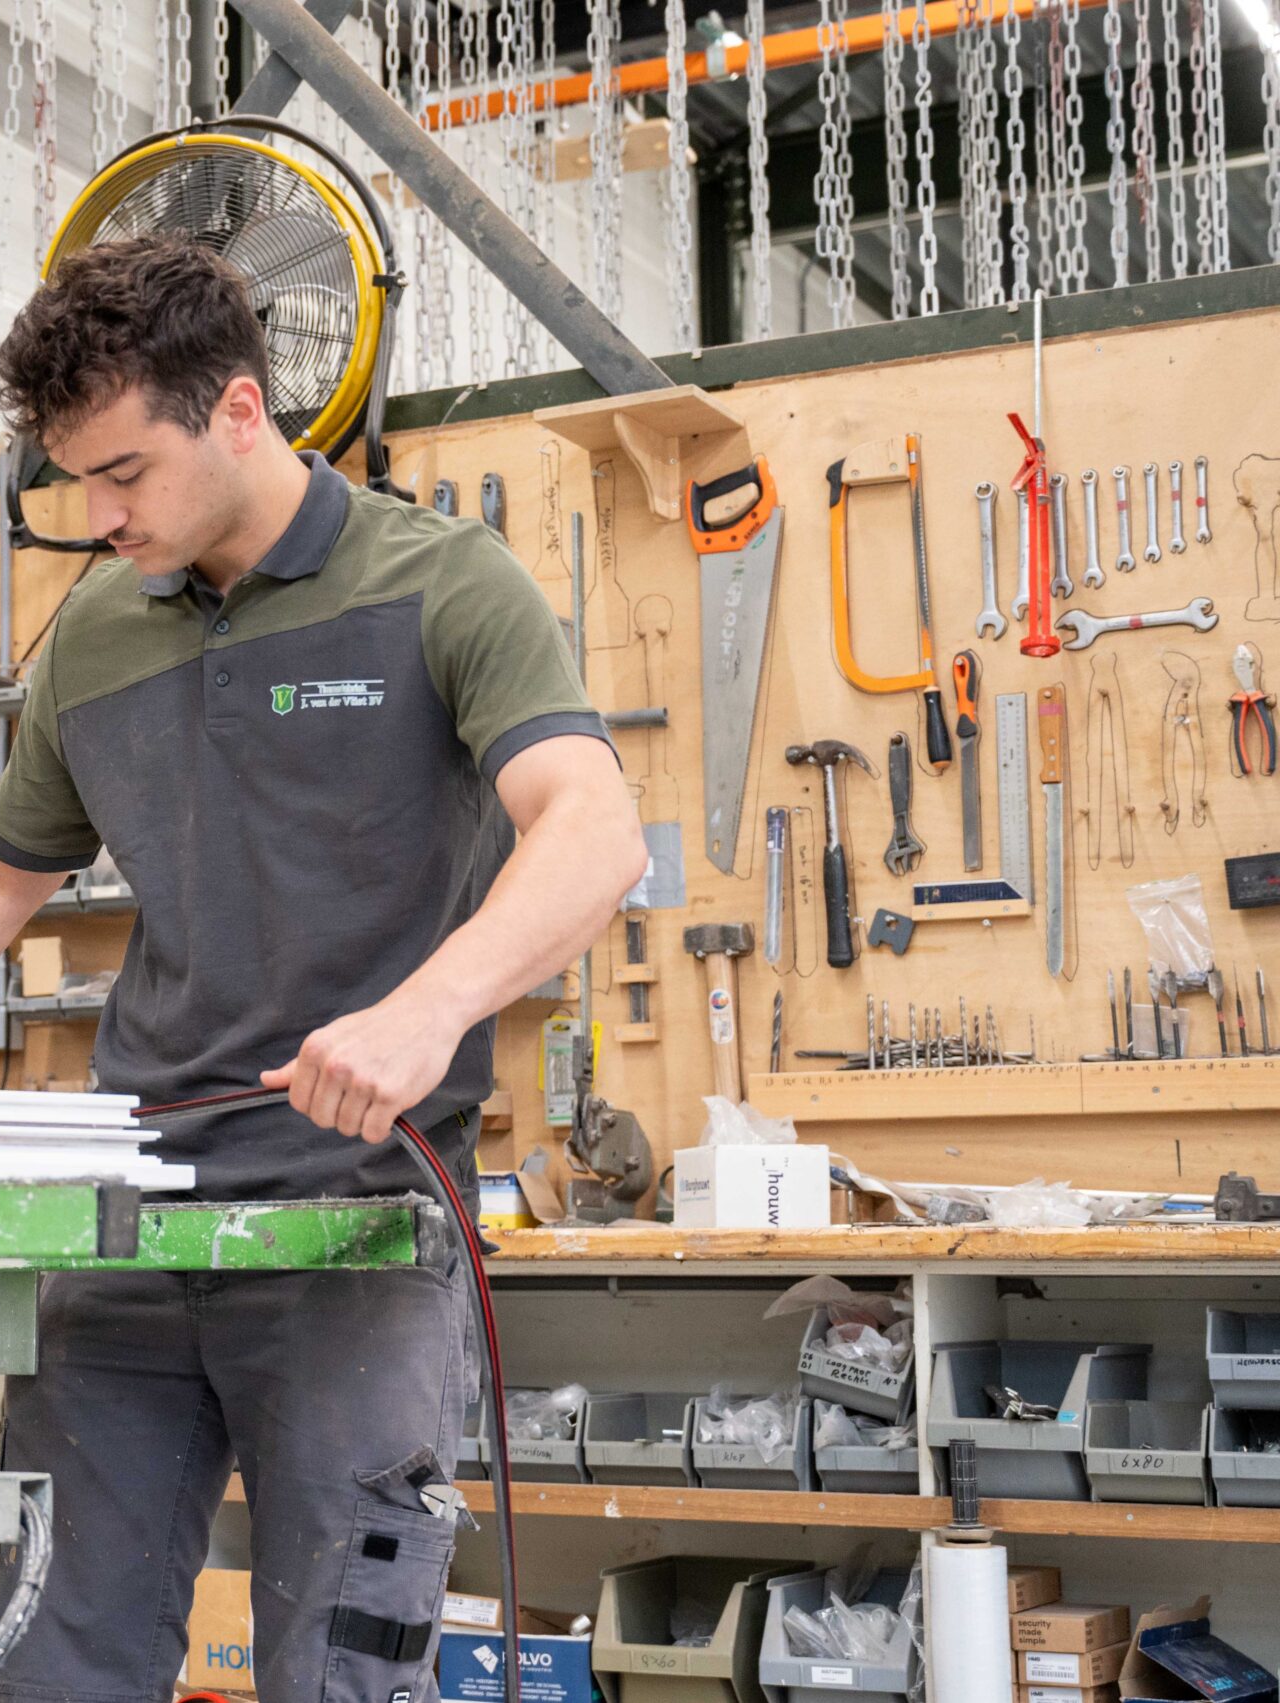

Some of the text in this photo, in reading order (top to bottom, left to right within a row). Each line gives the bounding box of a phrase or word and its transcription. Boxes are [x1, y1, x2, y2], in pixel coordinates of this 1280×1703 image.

[277, 690, 289, 709] V
[1121, 1454, 1164, 1469] 6x80
[1017, 1619, 1051, 1630] security
[1018, 1628, 1042, 1636] made
[1018, 1637, 1046, 1646] simple
